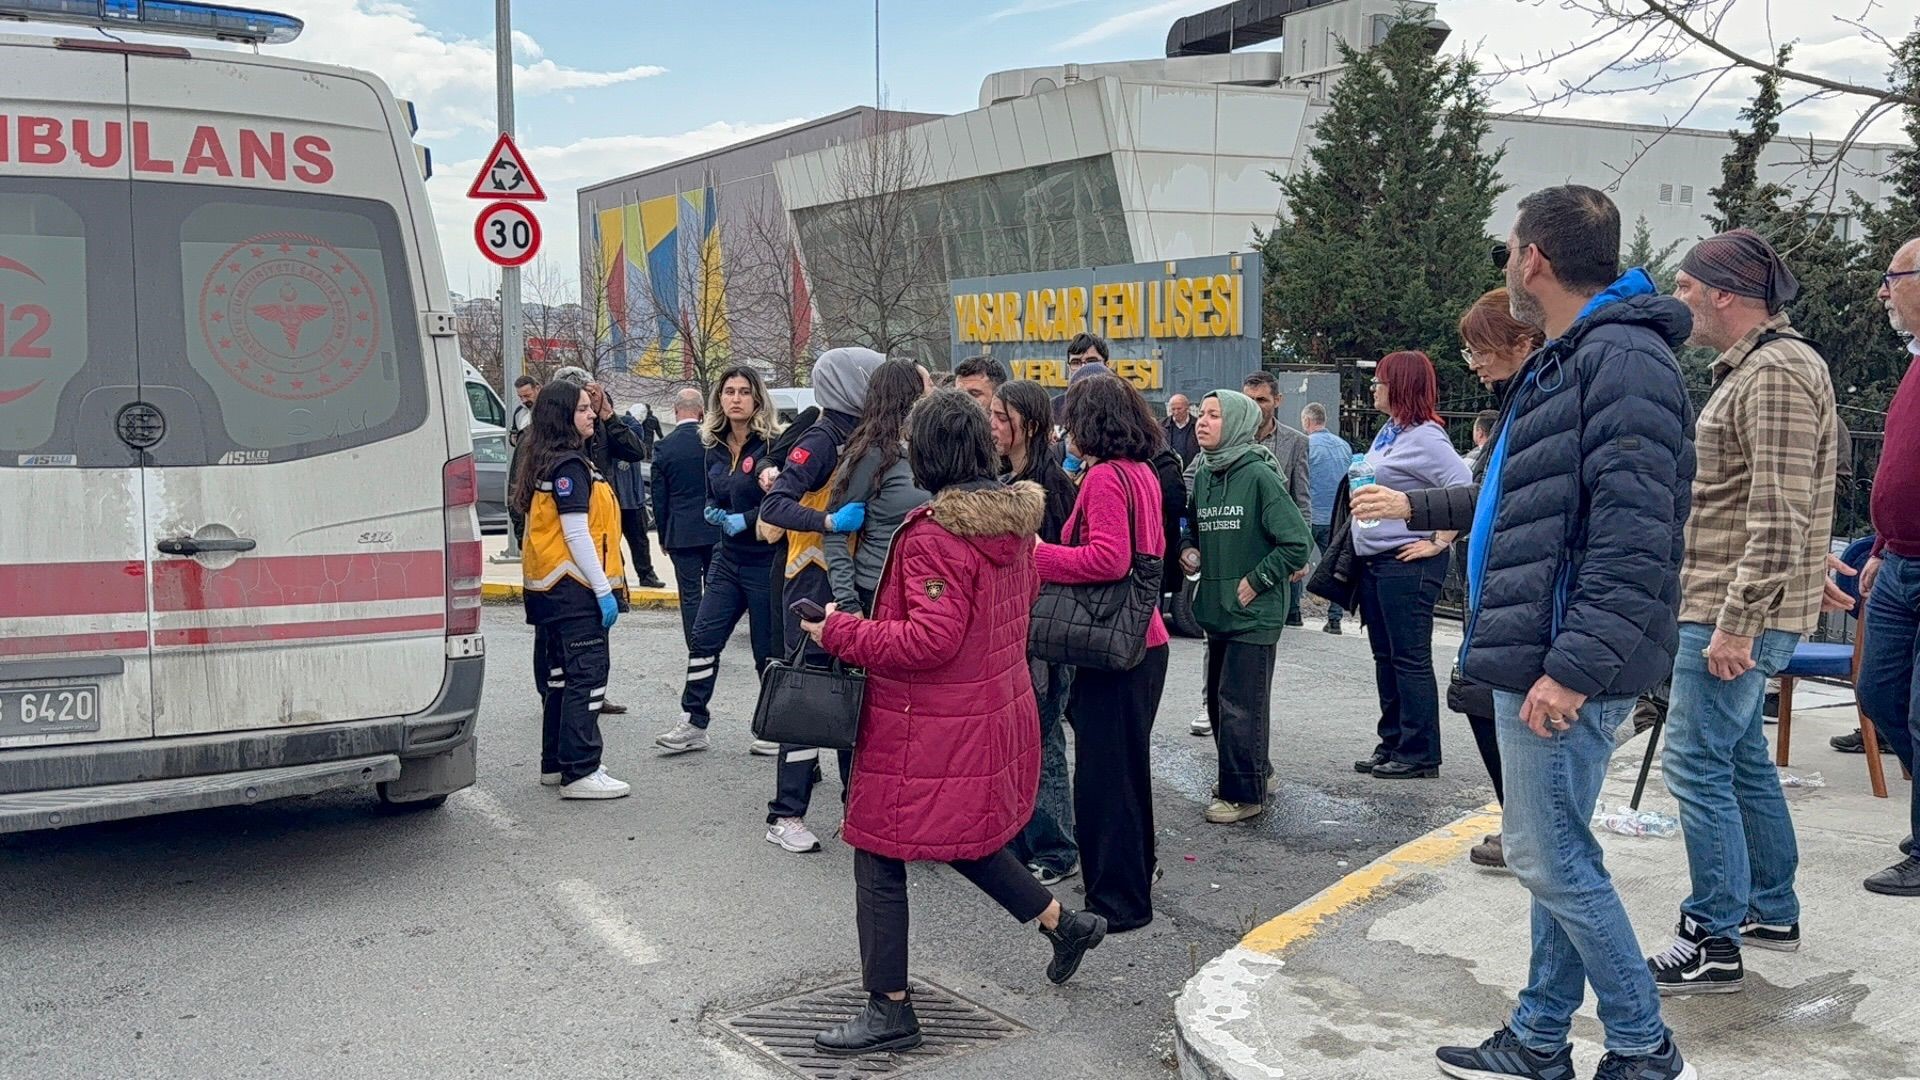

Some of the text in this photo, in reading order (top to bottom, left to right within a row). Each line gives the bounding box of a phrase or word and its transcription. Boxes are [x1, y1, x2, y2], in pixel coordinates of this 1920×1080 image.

[0, 114, 335, 184] BULANS
[490, 219, 530, 249] 30
[1023, 286, 1088, 342] ACAR
[1092, 281, 1145, 339] FEN
[1148, 256, 1243, 338] LİSESİ
[20, 691, 92, 723] 6420
